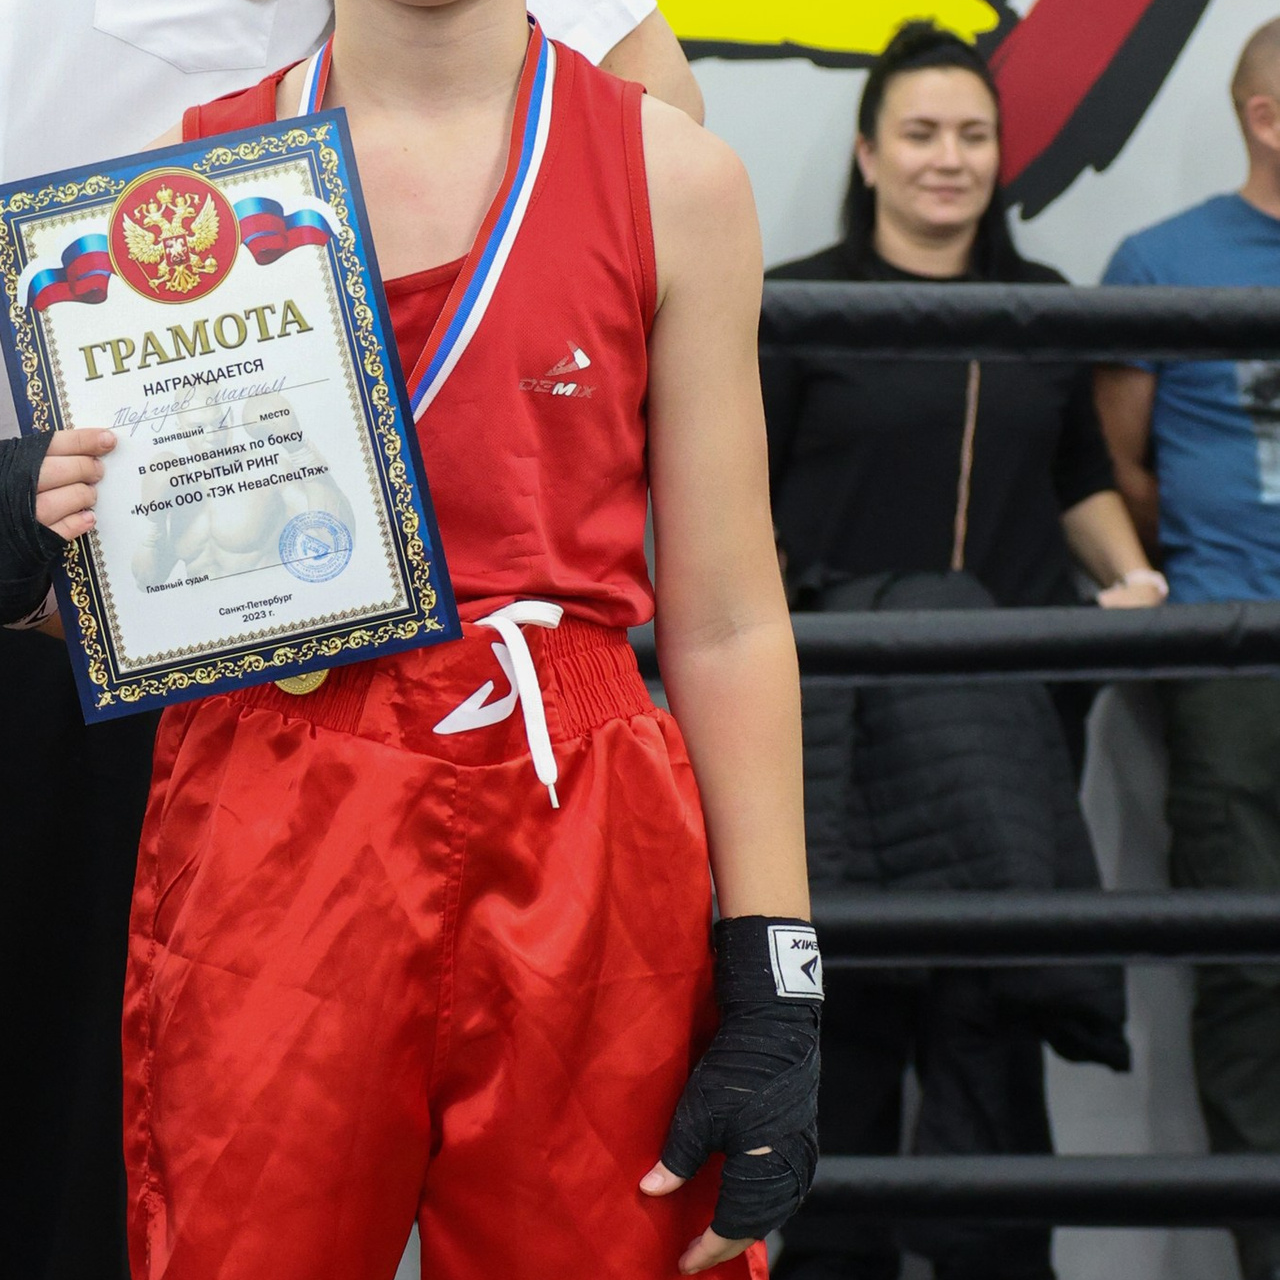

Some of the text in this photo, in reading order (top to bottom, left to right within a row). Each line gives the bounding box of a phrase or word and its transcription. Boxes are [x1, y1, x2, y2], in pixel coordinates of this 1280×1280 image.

[78, 299, 313, 381] ГРАМОТА
[143, 358, 264, 396] НАГРАЖДАЕТСЯ
[152, 427, 204, 445] занявший
[259, 408, 290, 421] место
[138, 430, 303, 475] в соревнованиях по боксу
[170, 454, 280, 487] ОТКРЫТЫЙ РИНГ
[131, 500, 173, 516] «Кубок
[175, 491, 202, 507] ООО
[207, 485, 235, 499] «ТЭК
[146, 574, 209, 593] Главный судья
[219, 593, 293, 616] Санкт-Петербург
[243, 611, 266, 622] 2023
